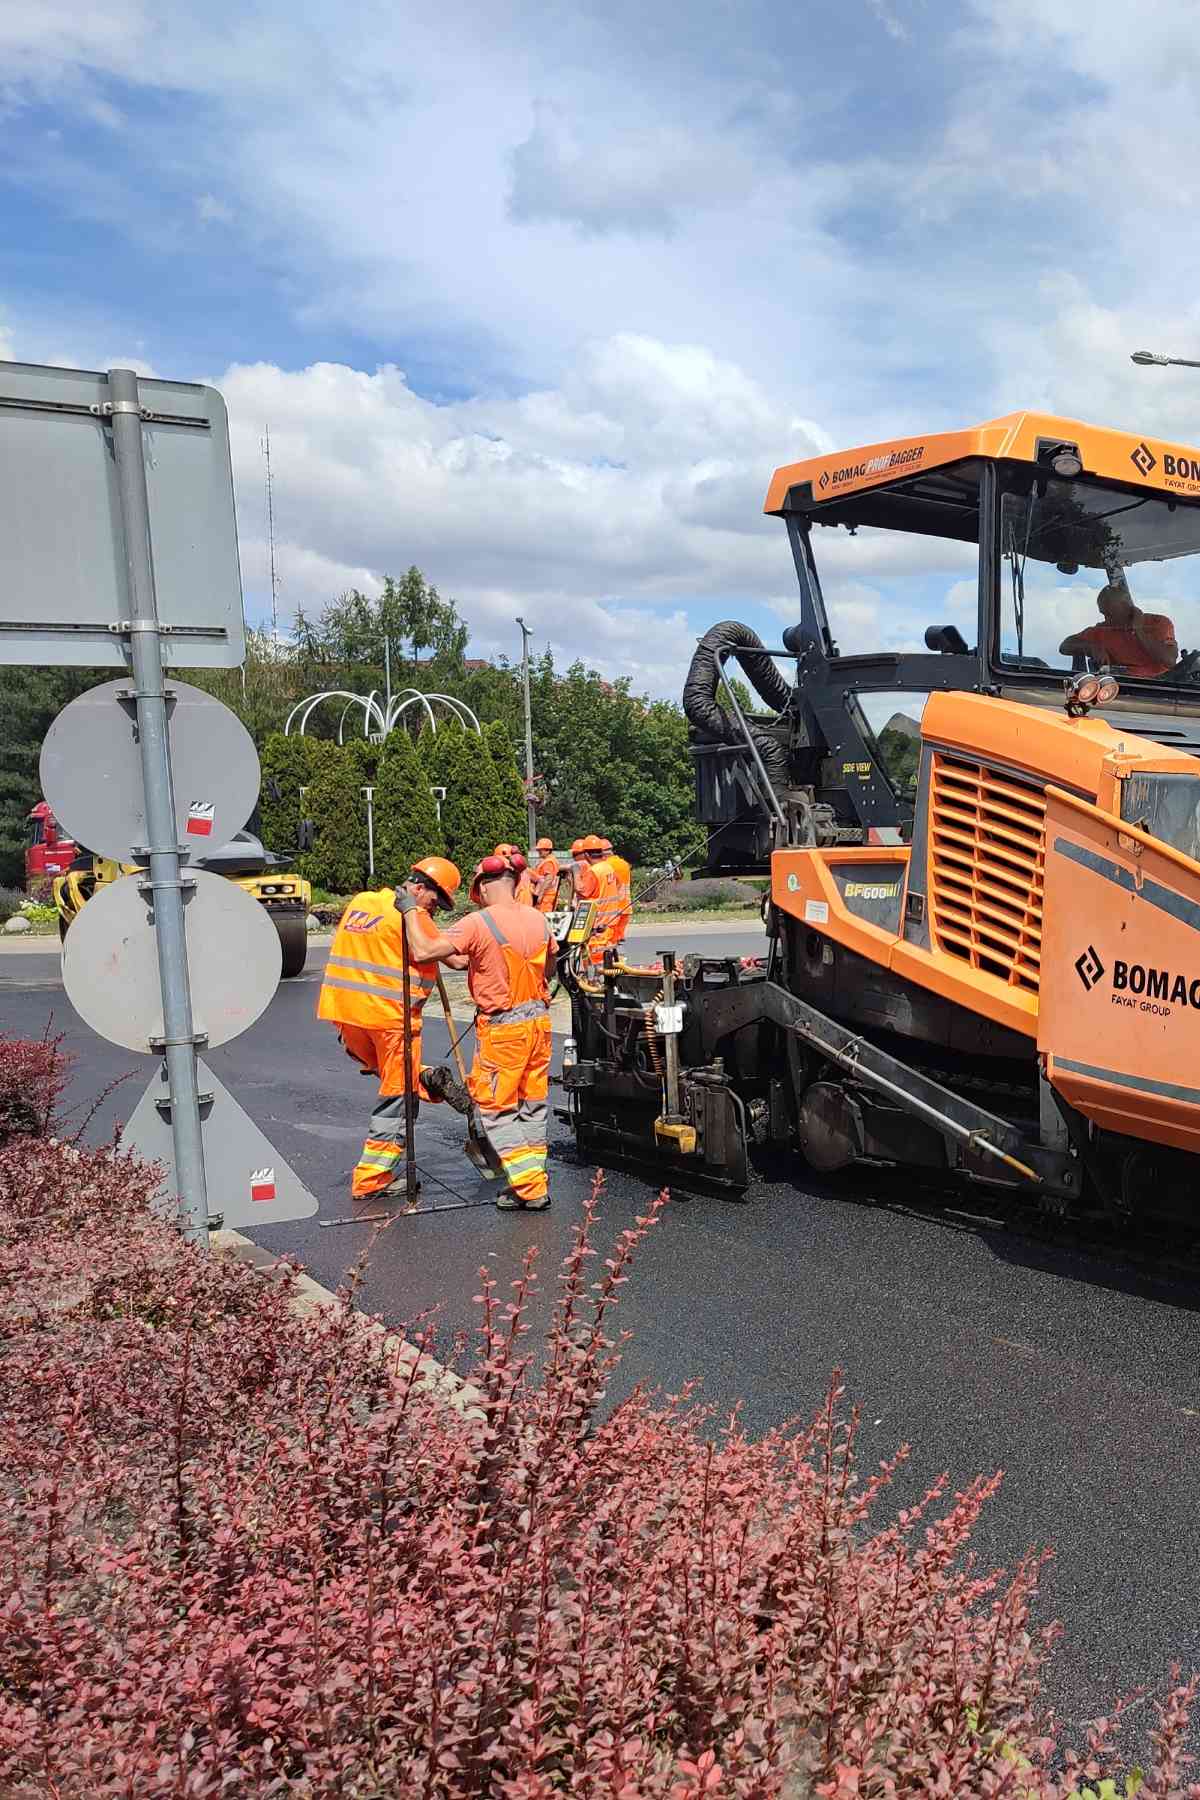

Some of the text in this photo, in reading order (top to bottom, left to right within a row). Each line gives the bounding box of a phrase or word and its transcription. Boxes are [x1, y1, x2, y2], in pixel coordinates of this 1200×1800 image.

[832, 463, 866, 483] BOMAG
[1164, 478, 1185, 489] FAYAT
[1111, 994, 1171, 1017] FAYAT GROUP
